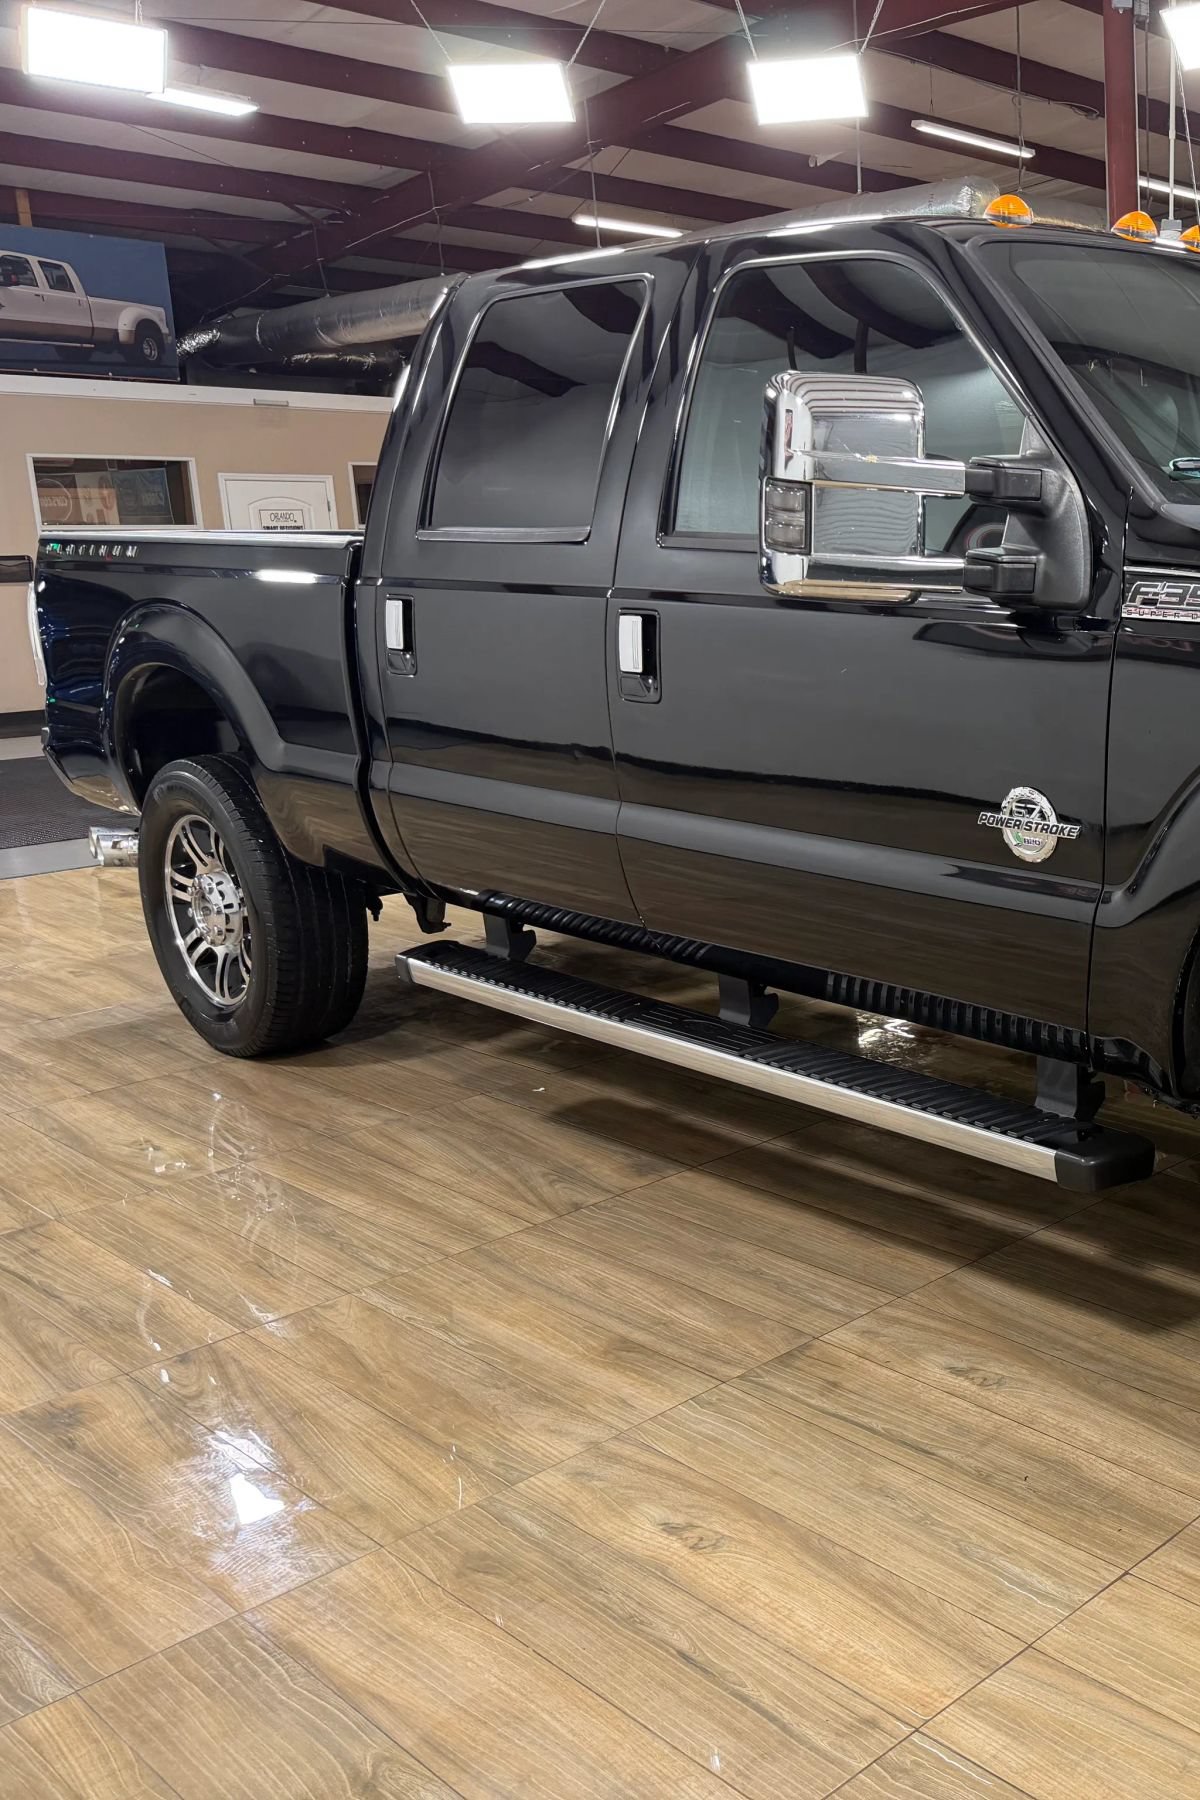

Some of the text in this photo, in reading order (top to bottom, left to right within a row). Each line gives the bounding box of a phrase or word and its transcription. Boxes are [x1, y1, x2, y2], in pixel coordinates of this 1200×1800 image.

[270, 512, 295, 521] ORLANDO
[1126, 609, 1180, 620] SUPER
[978, 812, 1080, 839] POWER STROKE
